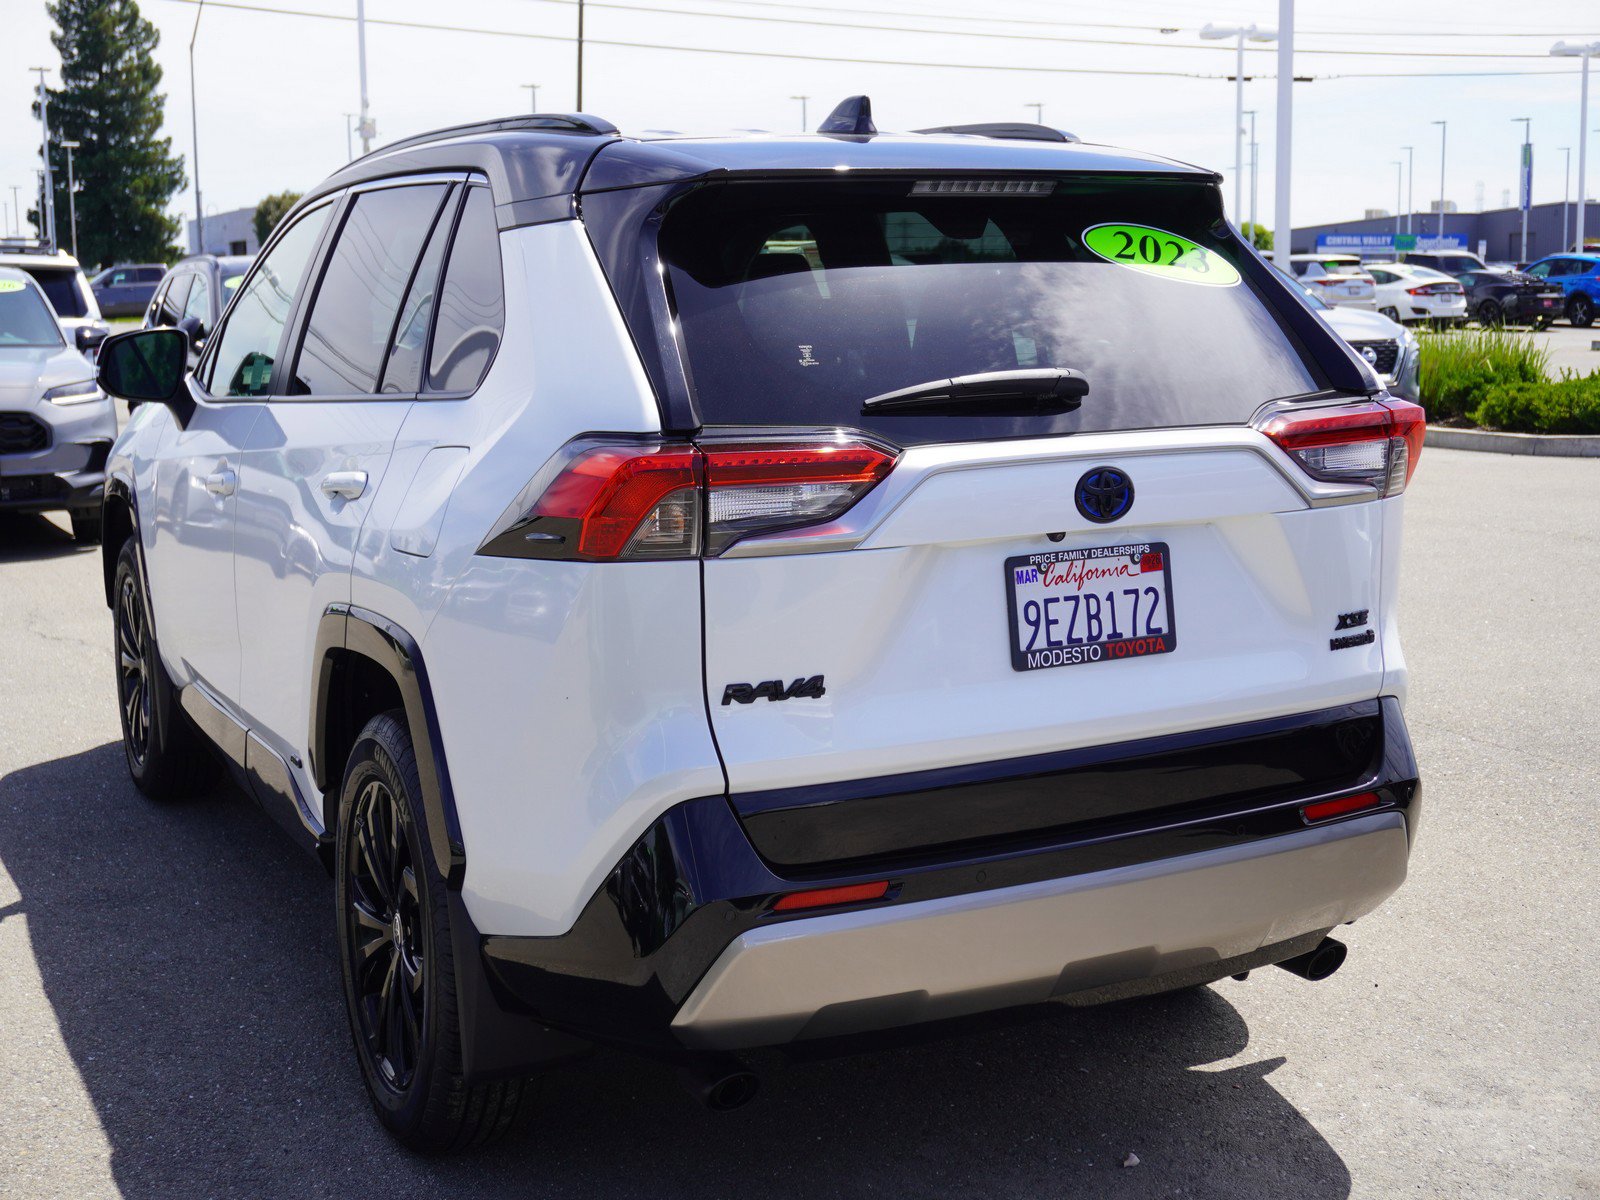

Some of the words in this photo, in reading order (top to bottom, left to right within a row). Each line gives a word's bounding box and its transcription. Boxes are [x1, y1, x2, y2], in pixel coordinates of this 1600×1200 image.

[1325, 235, 1362, 246] CENTRAL
[1362, 235, 1392, 246] VALLEY
[1029, 554, 1056, 565] PRICE
[1058, 549, 1089, 562] FAMILY
[1091, 544, 1150, 559] DEALERSHIPS
[1015, 568, 1039, 585] MAR
[1042, 558, 1140, 591] California
[1023, 586, 1163, 651] 9EZB172
[1027, 645, 1102, 669] MODESTO
[1106, 637, 1166, 658] TOYOTA
[721, 675, 826, 706] RAV4
